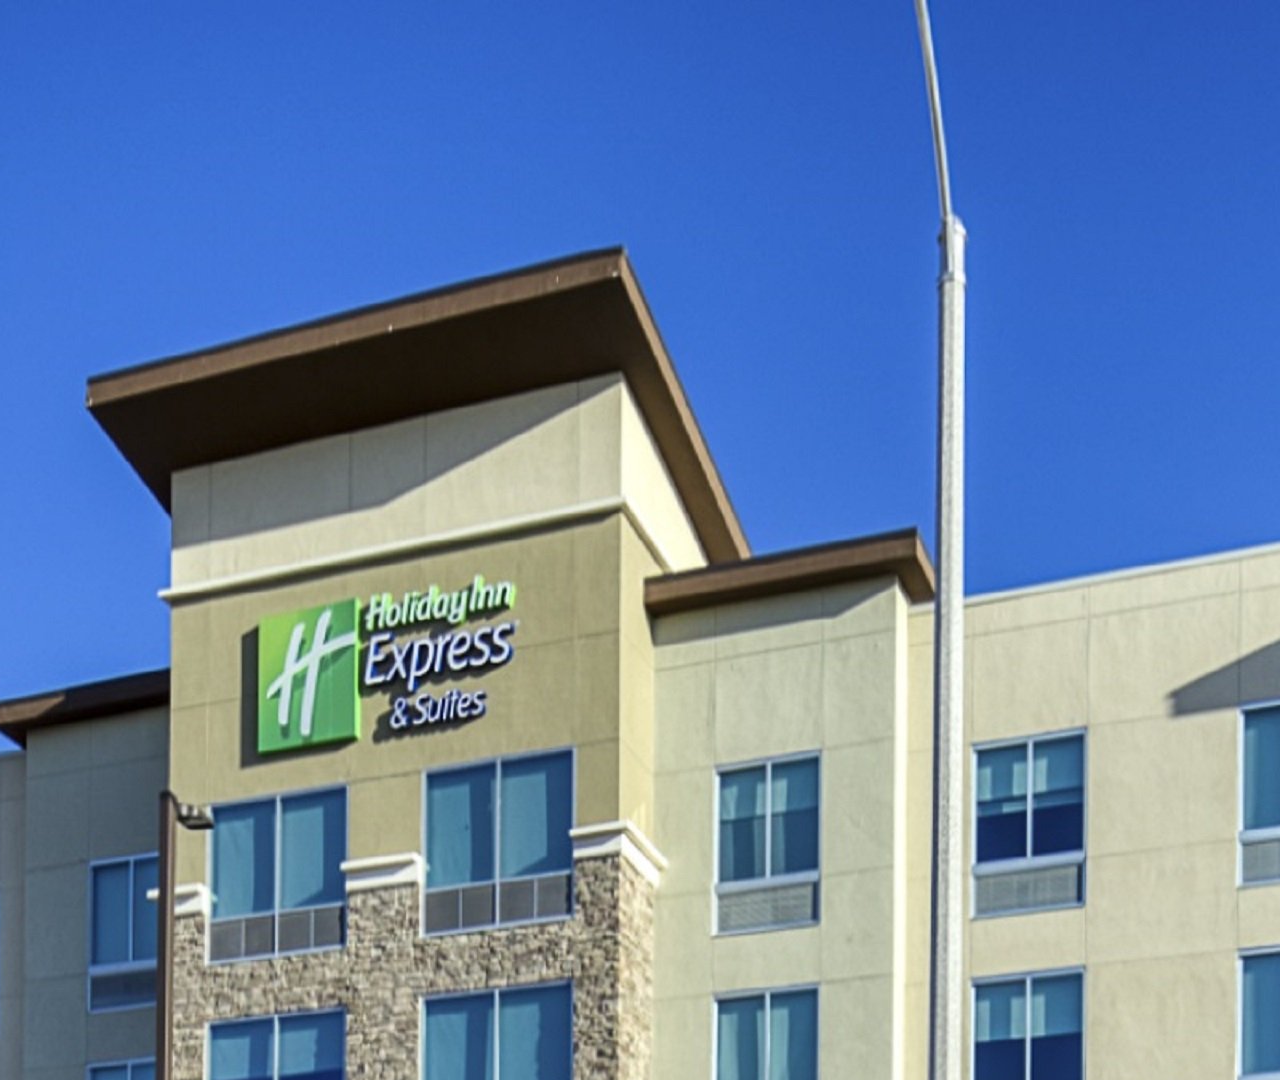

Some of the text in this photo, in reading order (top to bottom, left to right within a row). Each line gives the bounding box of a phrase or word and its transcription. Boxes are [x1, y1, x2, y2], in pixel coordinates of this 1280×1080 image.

[365, 574, 515, 631] Holiday Inn
[364, 622, 515, 692] Express
[389, 688, 486, 729] & Suites
